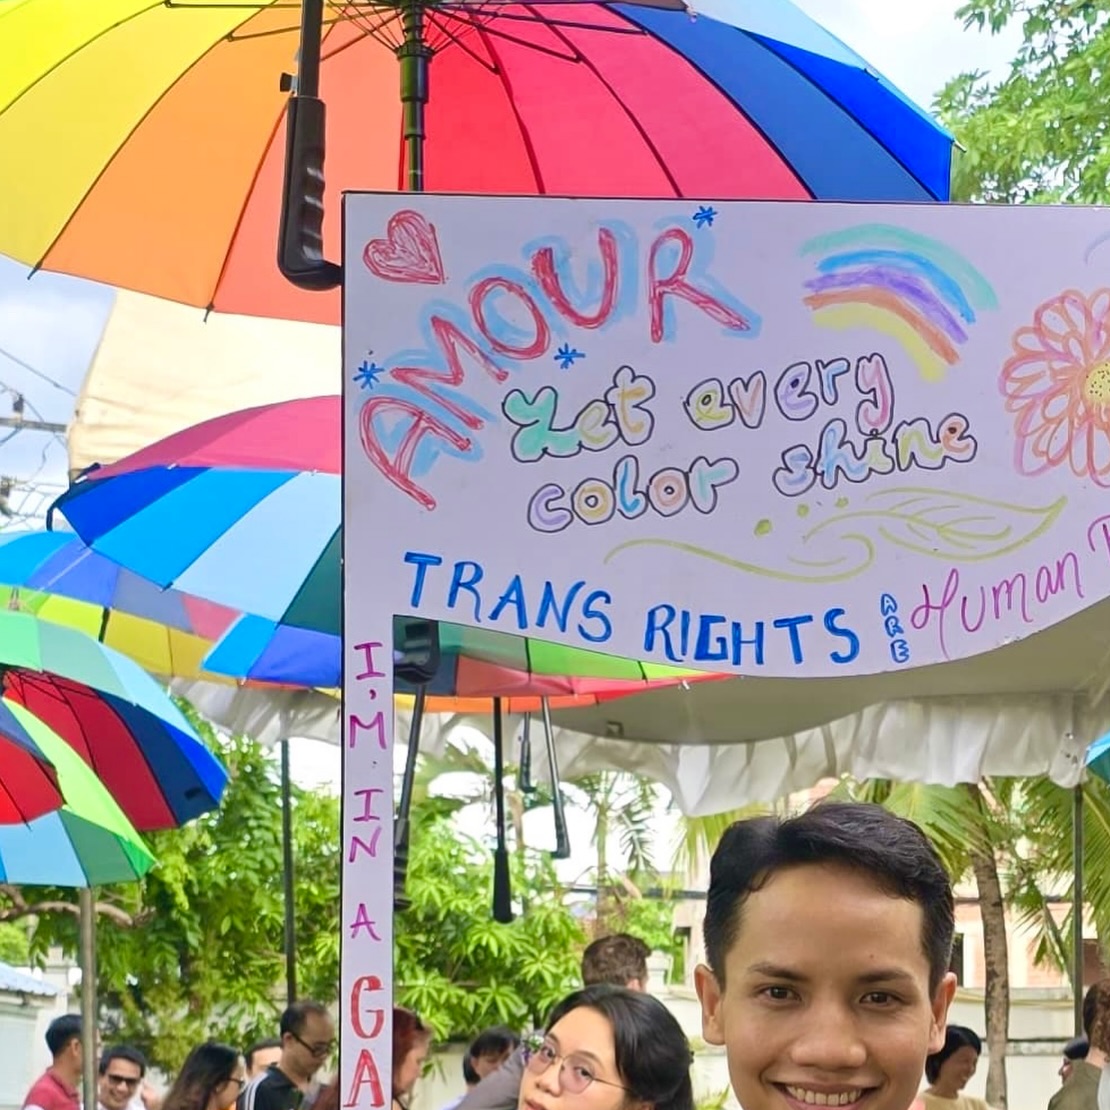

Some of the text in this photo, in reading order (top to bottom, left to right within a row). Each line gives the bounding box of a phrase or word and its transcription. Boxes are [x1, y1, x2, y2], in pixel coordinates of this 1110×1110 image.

[359, 227, 750, 511] AMOUR
[684, 352, 895, 436] every
[527, 413, 978, 533] color shine
[403, 550, 613, 643] TRANS
[644, 604, 860, 665] RIGHTS
[880, 594, 910, 664] ARE
[911, 551, 1084, 660] Human
[348, 788, 382, 863] IN
[350, 903, 382, 941] A
